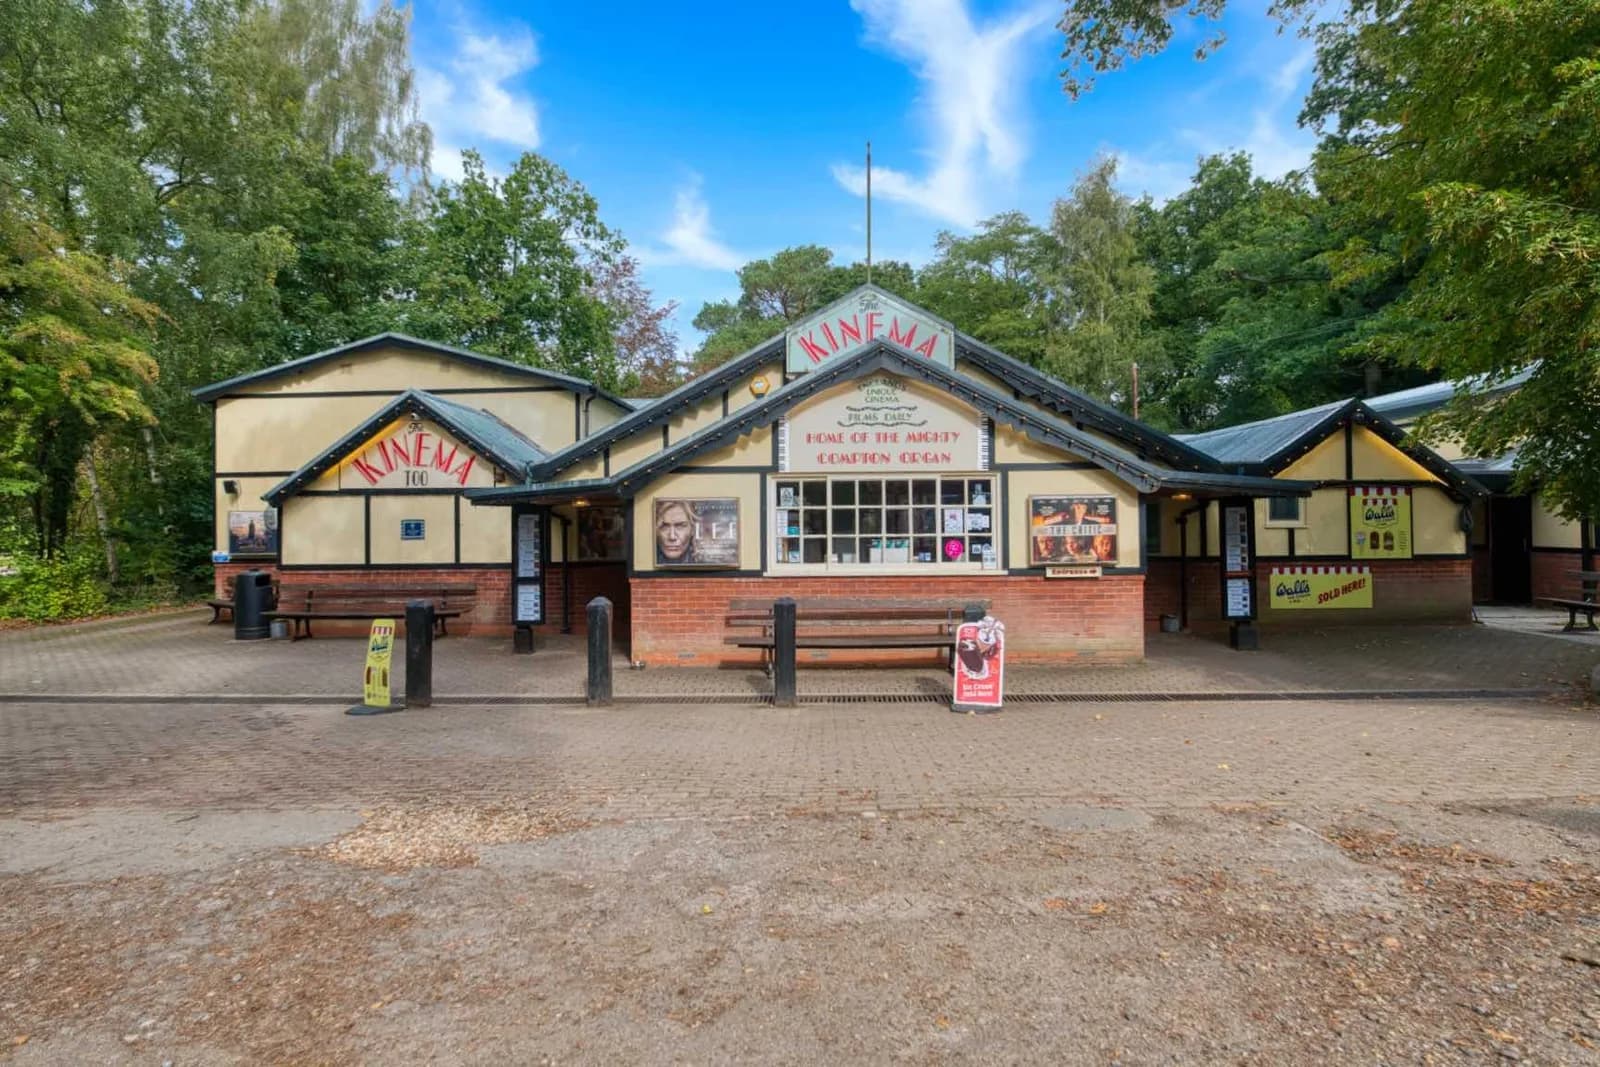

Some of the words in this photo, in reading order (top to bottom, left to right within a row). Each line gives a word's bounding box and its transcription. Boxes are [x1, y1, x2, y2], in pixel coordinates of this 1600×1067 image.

[797, 312, 938, 365] KINEMA
[806, 432, 845, 444] HOME
[850, 432, 870, 444] OF
[875, 432, 899, 443] THE
[906, 431, 961, 444] MIGHTY
[351, 432, 477, 486] KINEMA
[817, 452, 891, 465] COMPTON
[899, 452, 952, 464] ORGAN
[404, 470, 429, 487] TOO
[1317, 588, 1340, 604] SOLD
[1341, 578, 1366, 595] HERE!
